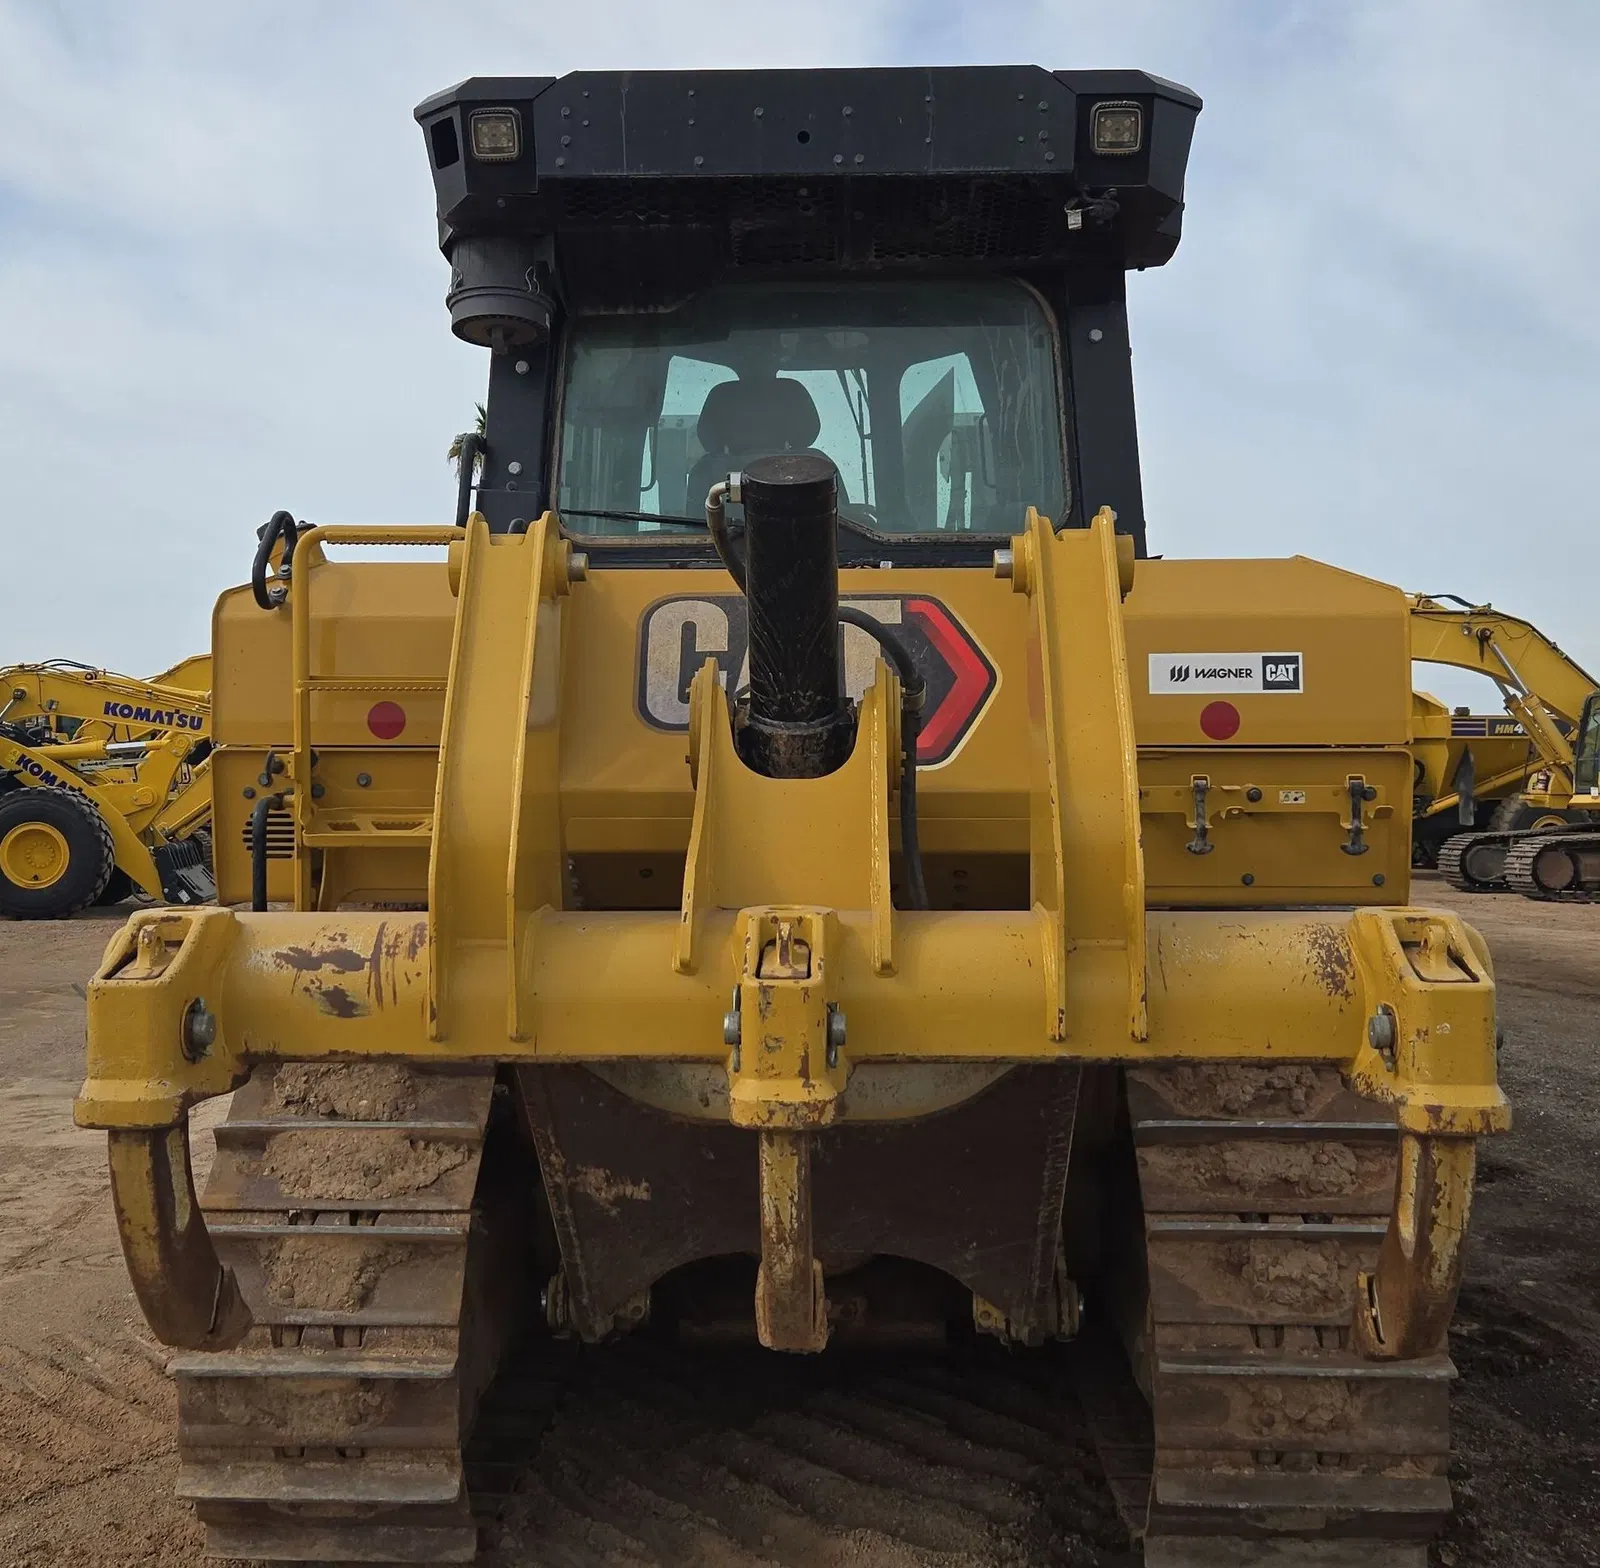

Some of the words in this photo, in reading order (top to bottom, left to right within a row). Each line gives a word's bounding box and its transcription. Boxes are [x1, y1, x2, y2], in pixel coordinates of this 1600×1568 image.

[1194, 668, 1253, 679] WAGNER
[1265, 664, 1297, 682] CAT
[103, 700, 203, 731] KOMATSU
[1494, 723, 1527, 735] HM4
